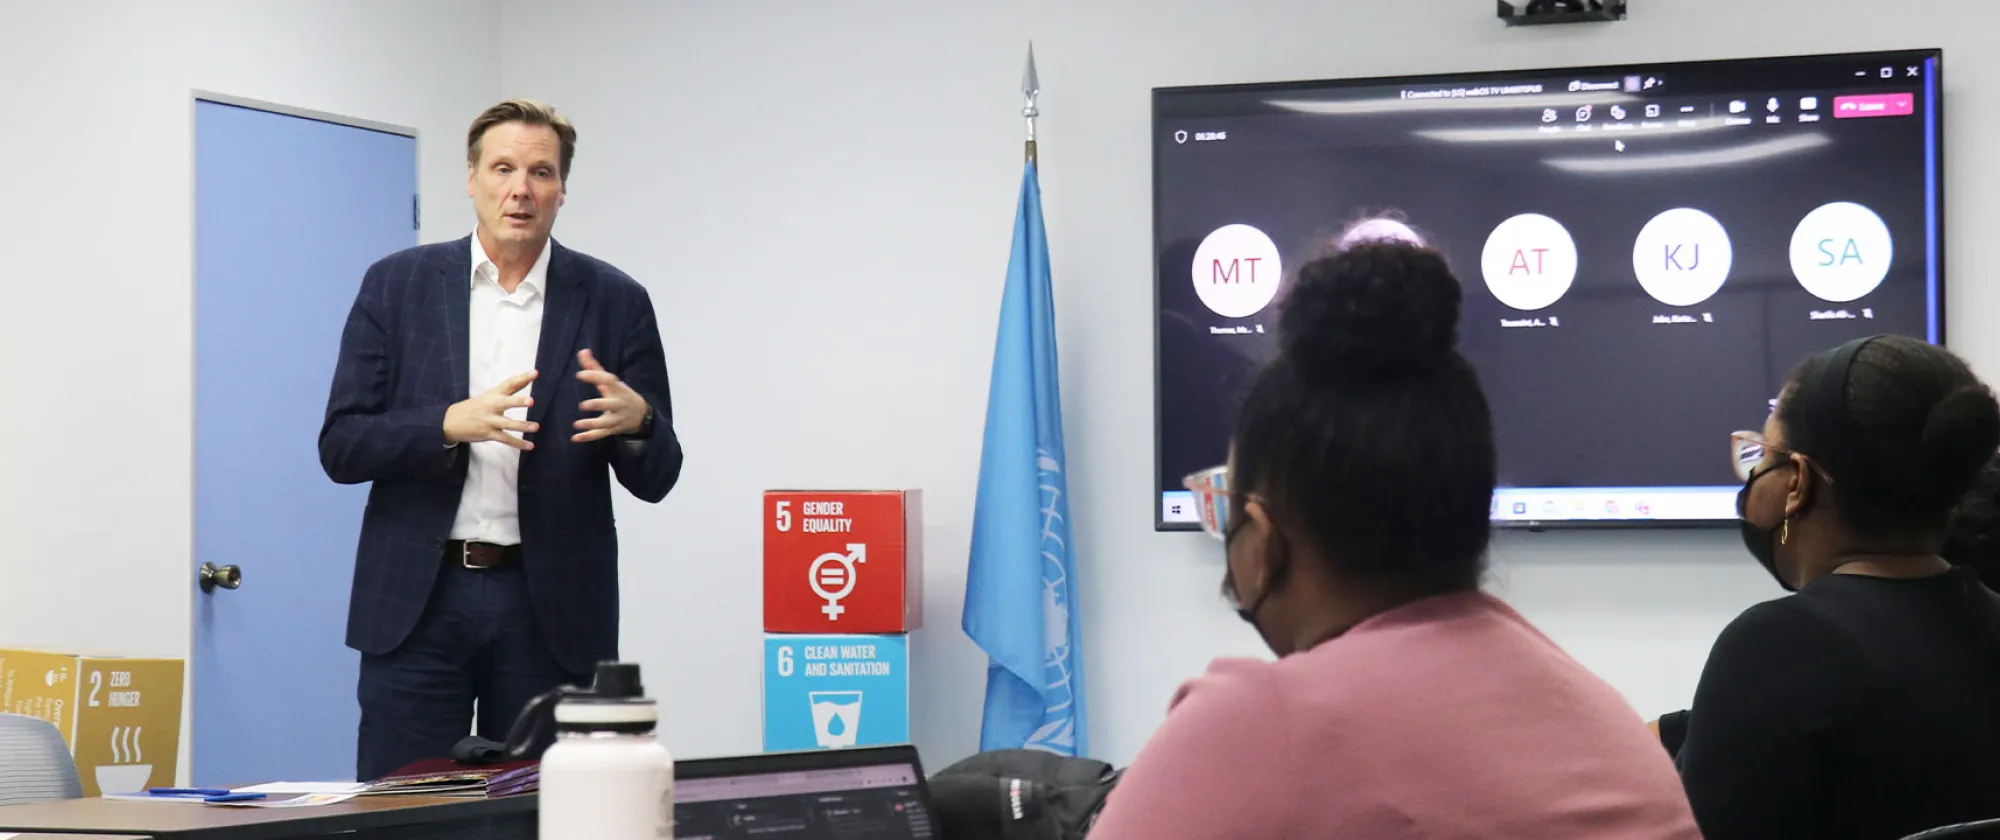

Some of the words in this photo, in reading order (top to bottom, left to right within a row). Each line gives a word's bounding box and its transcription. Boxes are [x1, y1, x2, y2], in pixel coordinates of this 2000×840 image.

[1508, 248, 1549, 276] AT
[1664, 244, 1700, 271] KJ
[1817, 238, 1864, 267] SA
[1212, 257, 1262, 285] MT
[776, 500, 792, 533] 5
[803, 501, 843, 516] GENDER
[803, 518, 852, 534] EQUALITY
[777, 645, 794, 677] 6
[804, 645, 837, 660] CLEAN
[841, 645, 876, 659] WATER
[109, 671, 131, 687] ZERO
[804, 662, 827, 677] AND
[829, 662, 890, 676] SANITATION
[88, 670, 102, 707] 2
[108, 690, 141, 707] HUNGER
